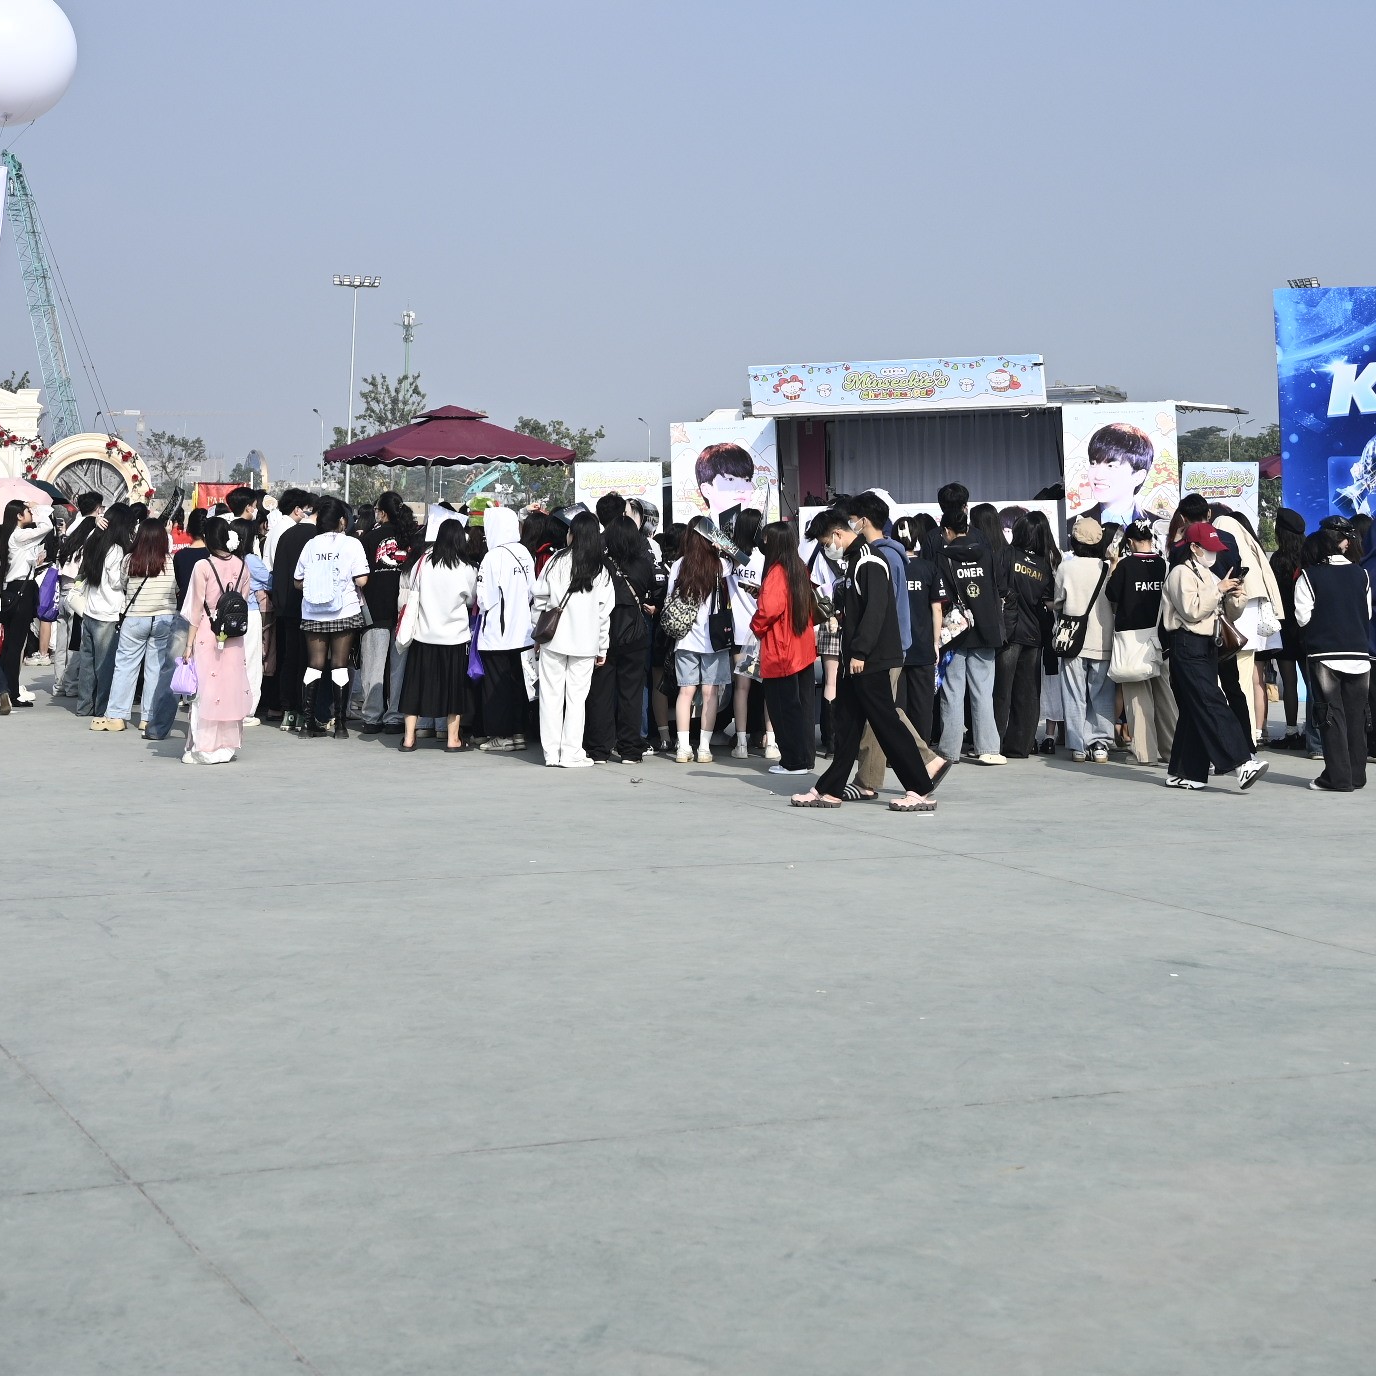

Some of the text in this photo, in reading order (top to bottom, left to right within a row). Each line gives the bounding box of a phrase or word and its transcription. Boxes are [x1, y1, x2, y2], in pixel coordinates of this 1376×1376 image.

[732, 568, 756, 579] AKER
[956, 567, 984, 579] ONER
[1014, 562, 1042, 581] DORAN
[905, 581, 922, 591] ER
